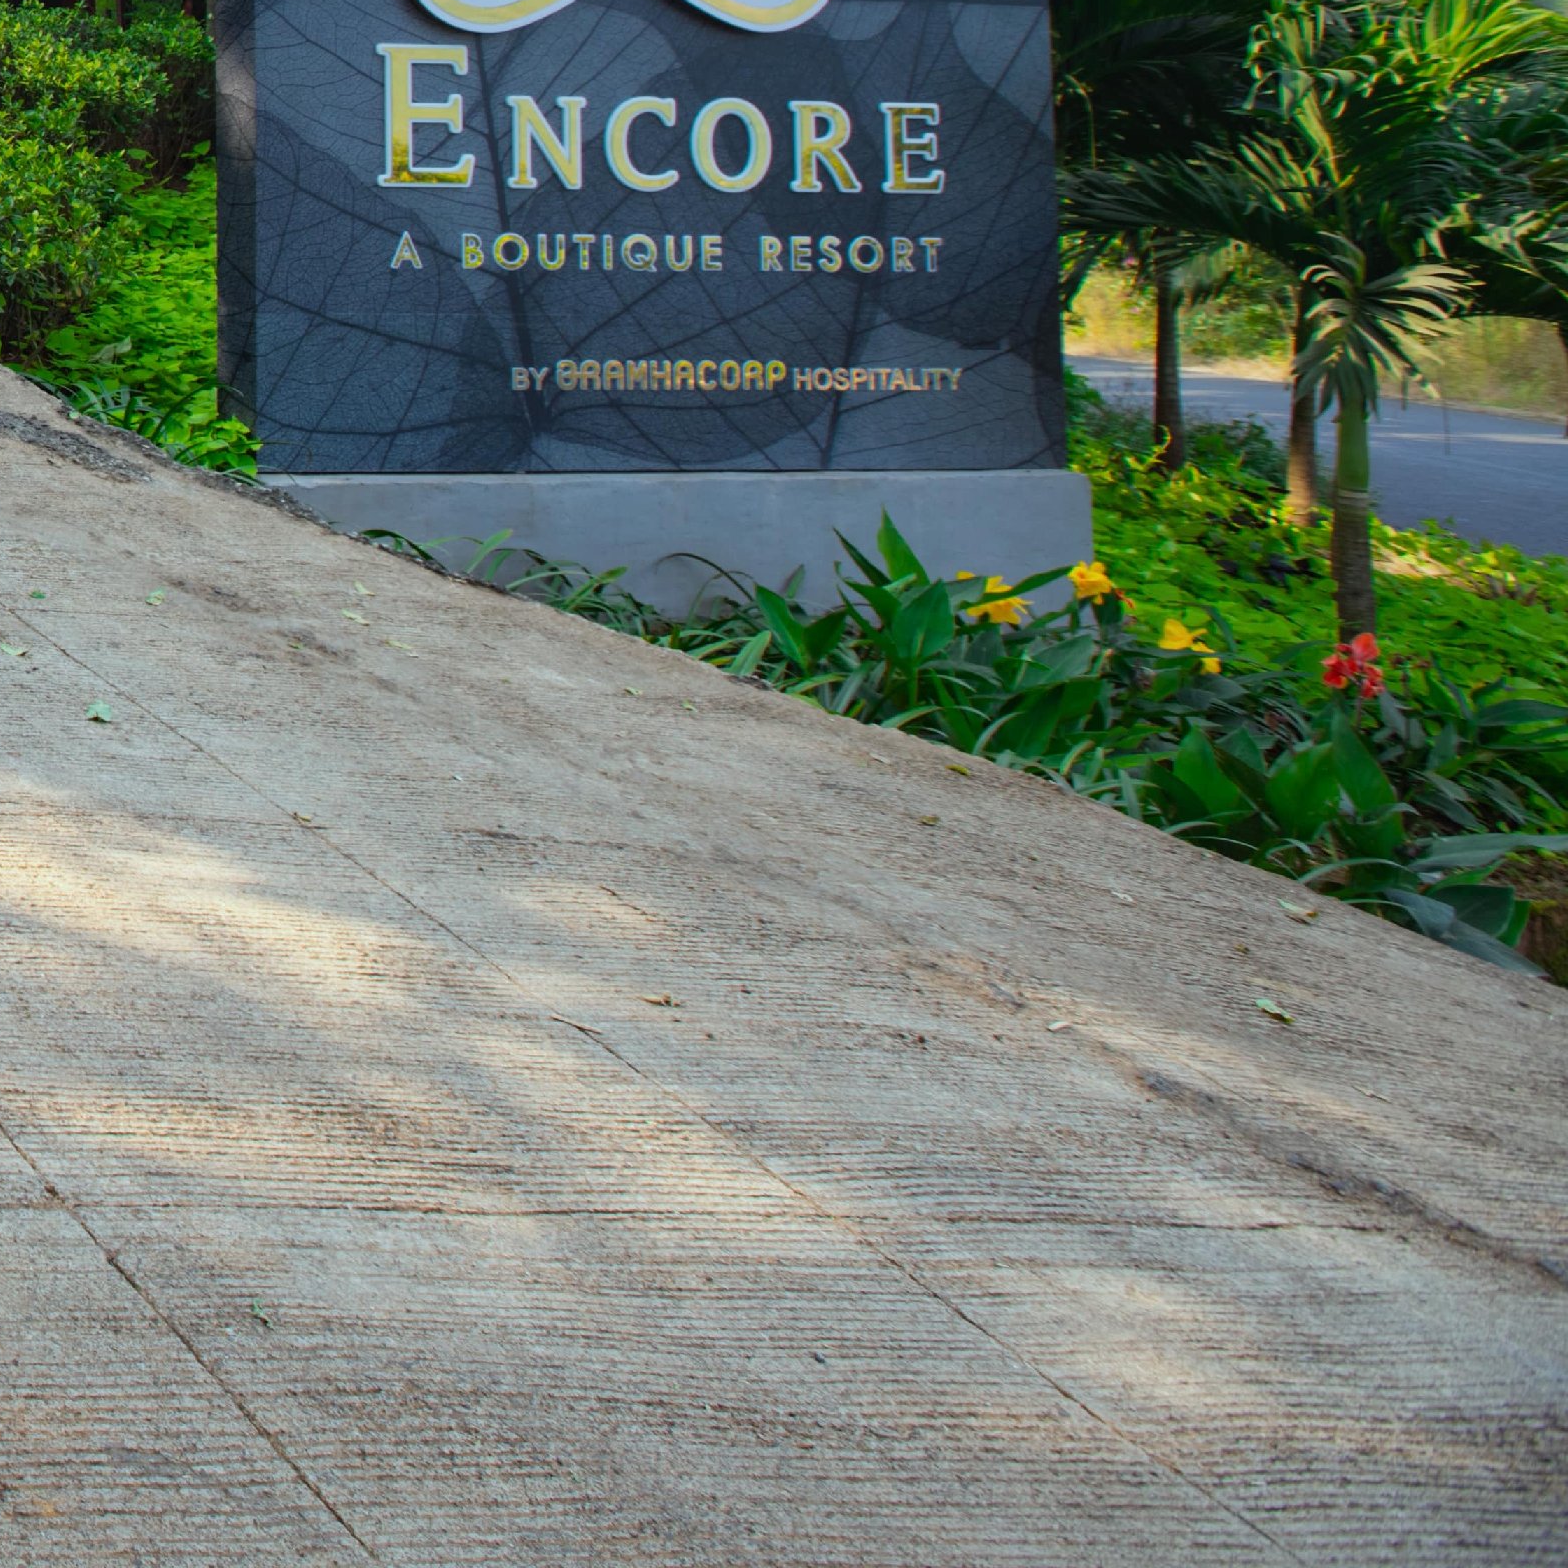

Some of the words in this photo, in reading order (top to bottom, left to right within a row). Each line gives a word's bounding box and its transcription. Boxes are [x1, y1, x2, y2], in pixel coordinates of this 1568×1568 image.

[376, 43, 945, 193] ENCORE
[390, 232, 422, 269] A
[461, 233, 723, 272] BOUTIQUE
[761, 235, 943, 273] RESORT
[512, 367, 549, 391] BY
[556, 360, 786, 391] BRAMHACORP
[794, 368, 961, 391] HOSPITALITY
